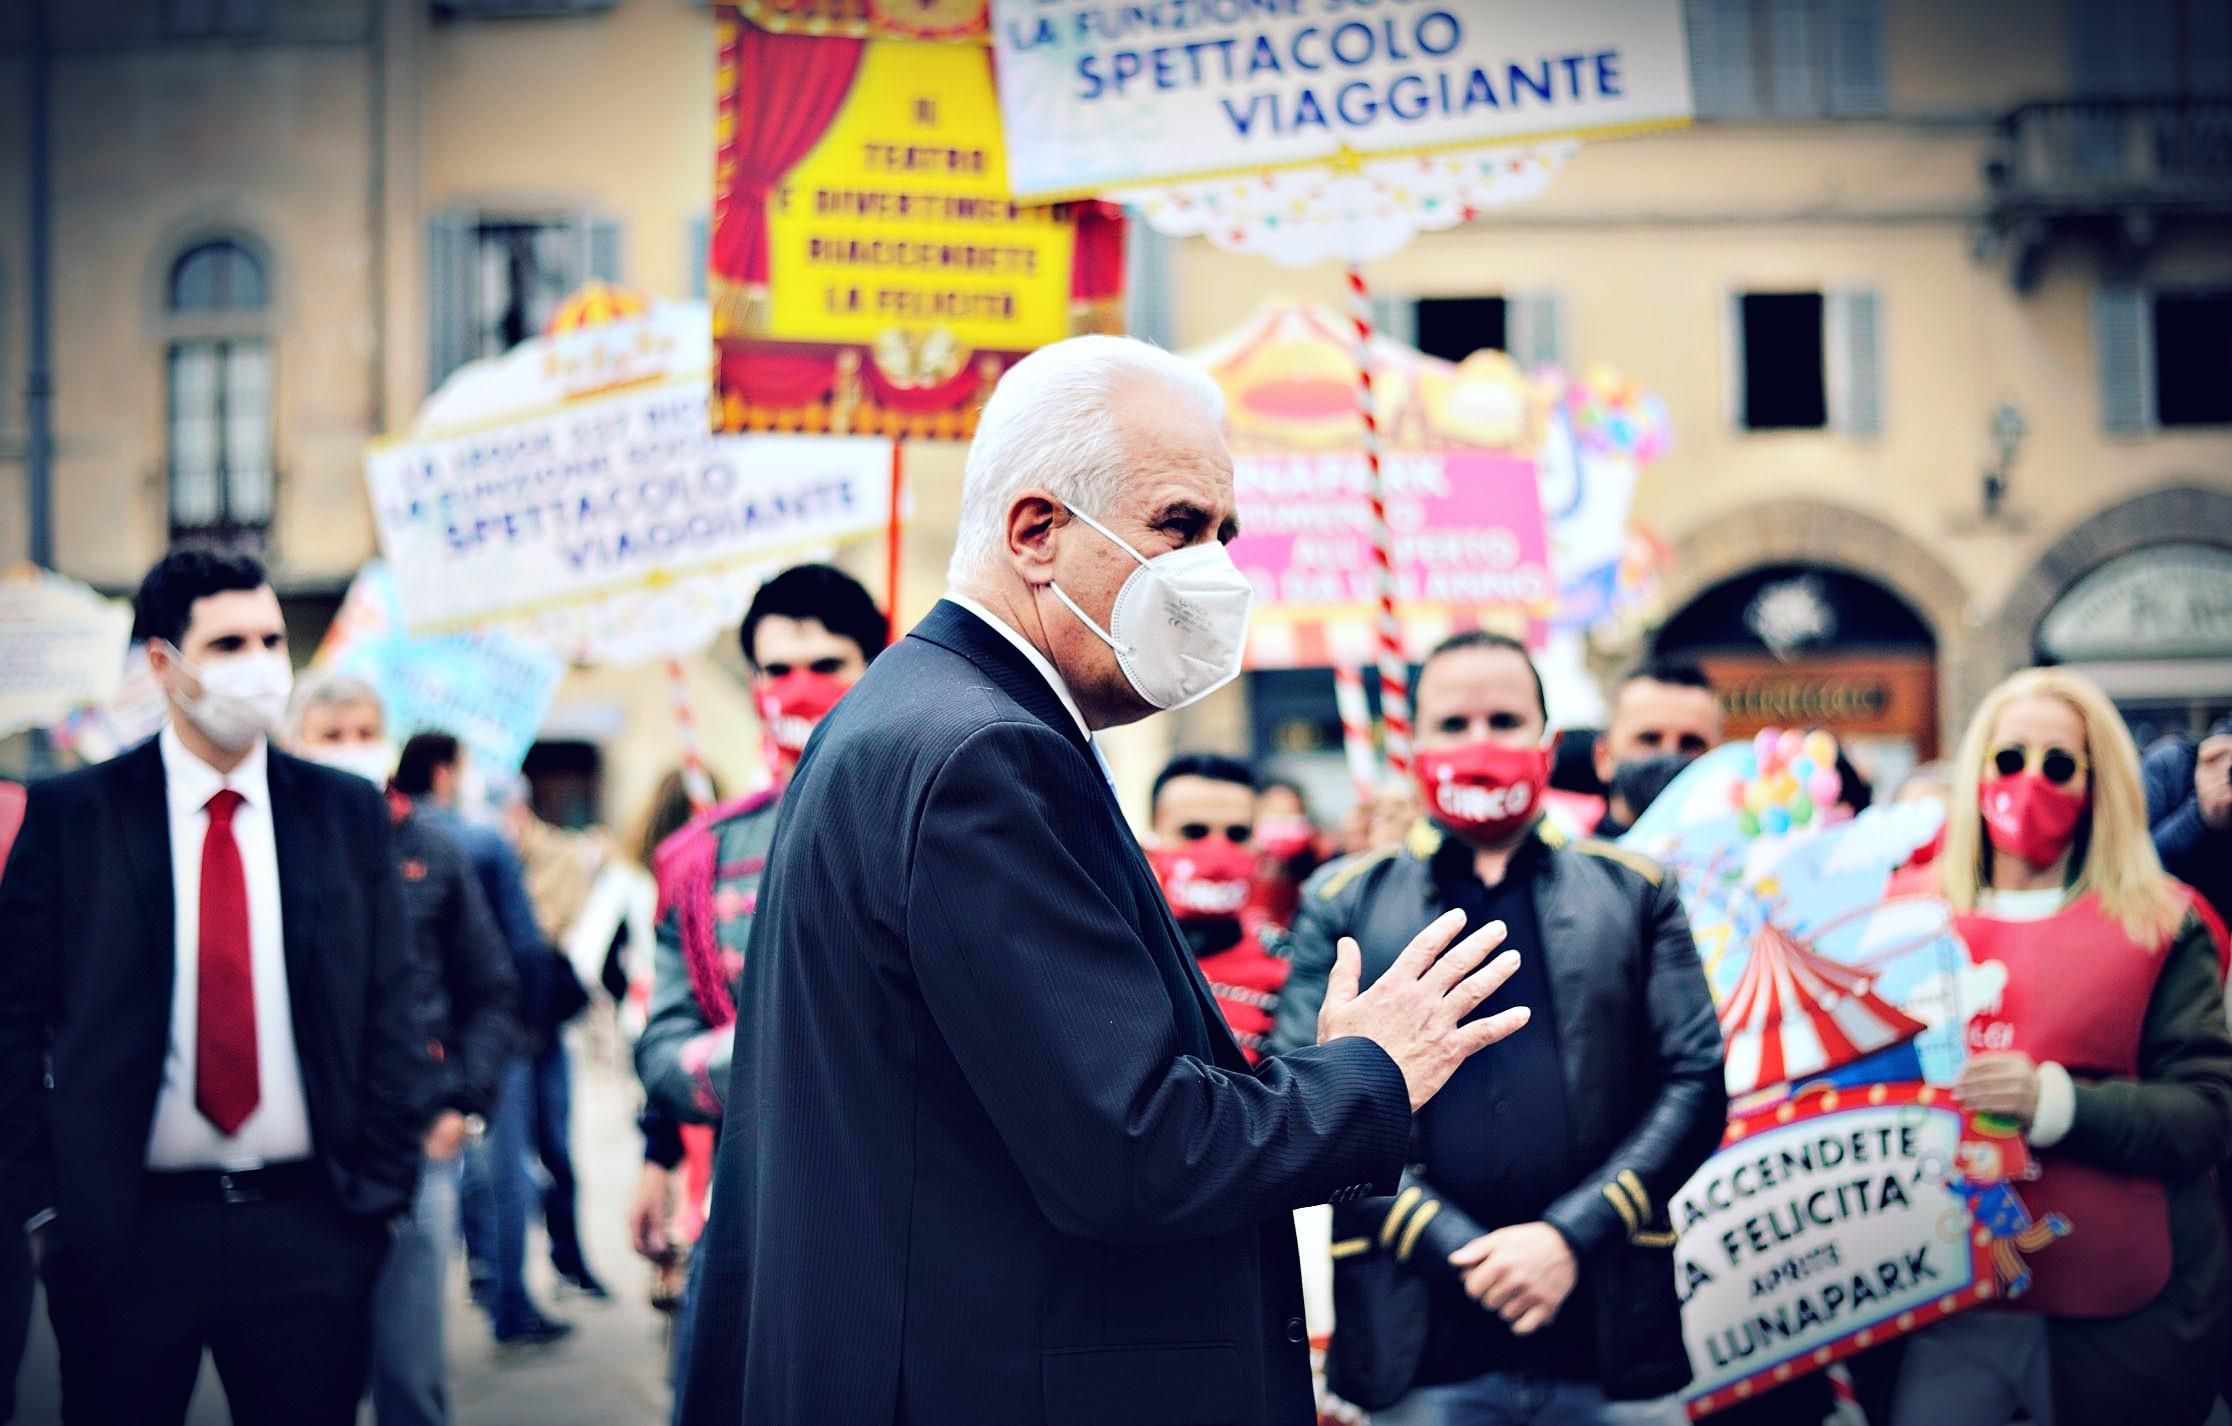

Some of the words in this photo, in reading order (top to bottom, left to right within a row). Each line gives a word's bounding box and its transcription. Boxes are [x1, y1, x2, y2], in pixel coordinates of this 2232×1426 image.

[1006, 17, 1056, 50] LA
[1078, 11, 1463, 99] SPETTACOLO
[1221, 50, 1623, 138] VIAGGIANTE
[864, 143, 987, 174] TEATRO
[826, 286, 861, 313] LA
[446, 463, 737, 551] SPETTACOLO
[562, 478, 861, 570] VIAGGIANTE
[1679, 1260, 1713, 1304] A
[1706, 1245, 1940, 1368] LUNAPARK
